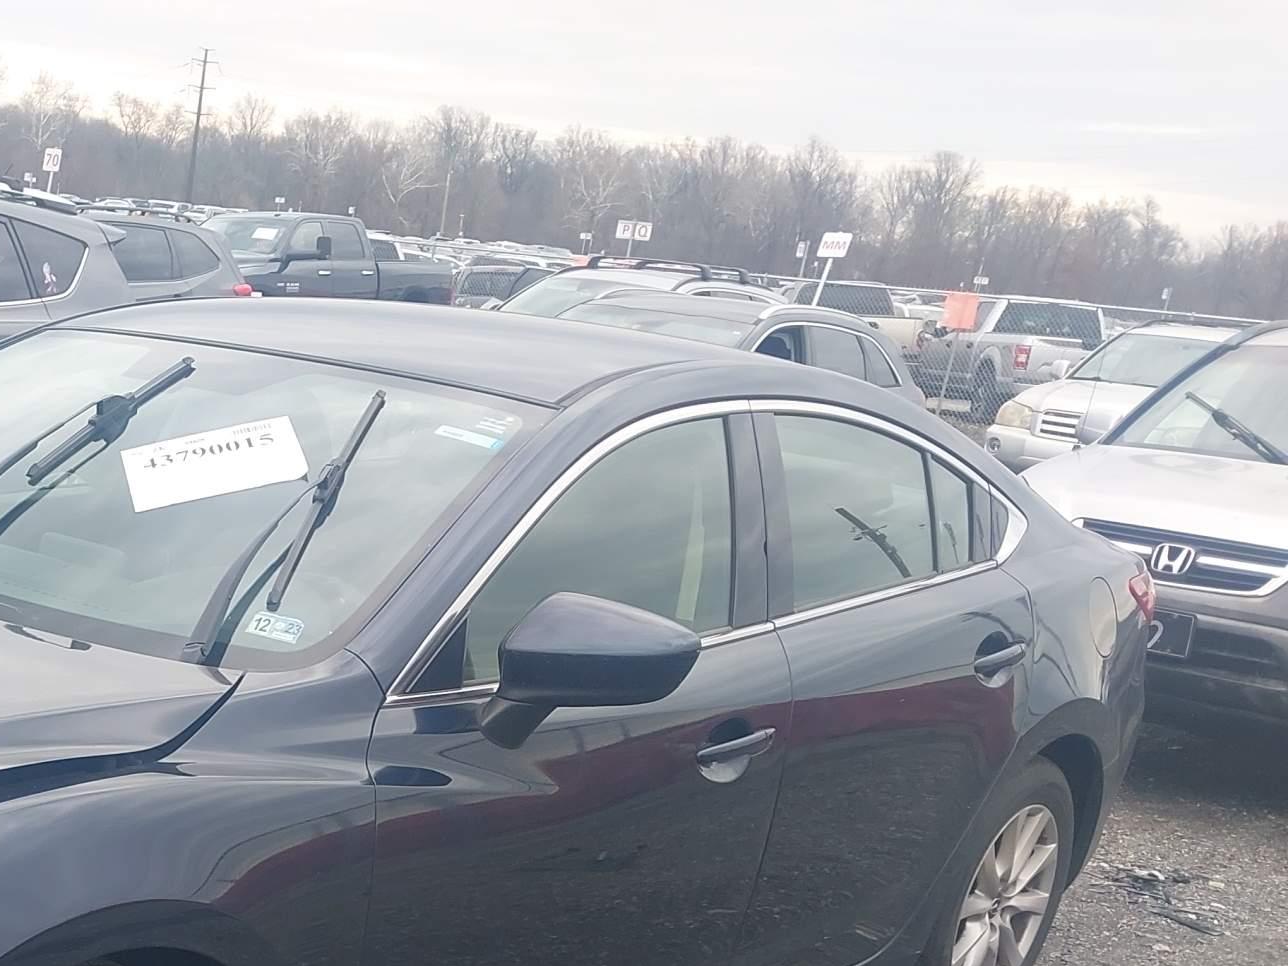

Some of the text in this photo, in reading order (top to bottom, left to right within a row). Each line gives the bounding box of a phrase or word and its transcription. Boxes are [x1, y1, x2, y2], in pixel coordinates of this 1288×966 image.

[46, 153, 59, 167] 70
[622, 224, 631, 235] P
[638, 224, 649, 238] Q
[822, 240, 847, 251] MM
[143, 433, 275, 469] 43790015
[254, 617, 272, 633] 12
